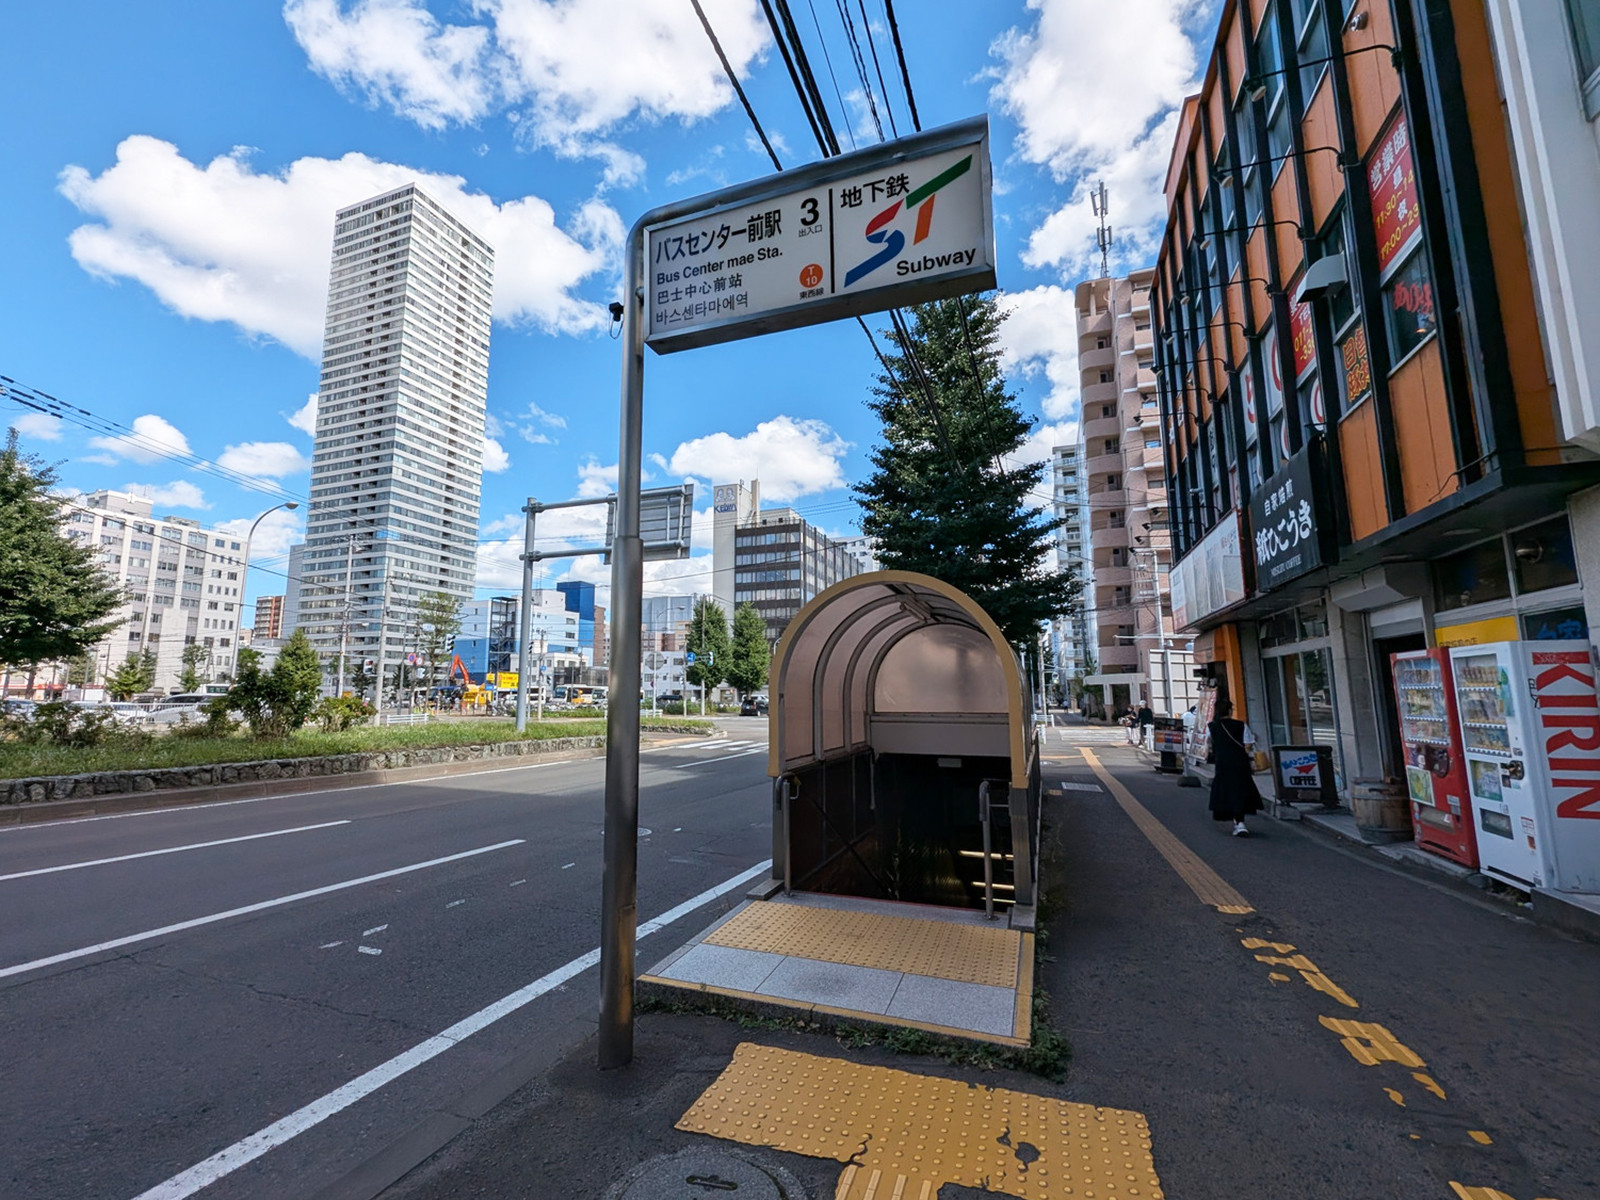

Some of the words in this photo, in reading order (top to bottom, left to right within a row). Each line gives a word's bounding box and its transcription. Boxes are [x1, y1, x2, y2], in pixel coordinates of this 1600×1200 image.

[841, 173, 910, 208] 地下鉄
[800, 198, 820, 226] 3
[656, 209, 782, 264] バスセンター前駅
[798, 225, 823, 237] 出入口
[657, 273, 680, 285] Bus
[683, 261, 724, 278] Center
[727, 253, 754, 268] mae
[757, 247, 783, 261] Sta.
[807, 266, 815, 275] T
[896, 248, 976, 276] Subway
[657, 273, 743, 305] 巴士中心前站
[799, 287, 824, 300] 東西線
[806, 276, 818, 285] 10
[656, 291, 748, 325] 바스센타마에역
[1255, 499, 1312, 566] 紙ひこうき
[1532, 651, 1600, 819] KIRIN
[1290, 776, 1318, 786] COFFEE
